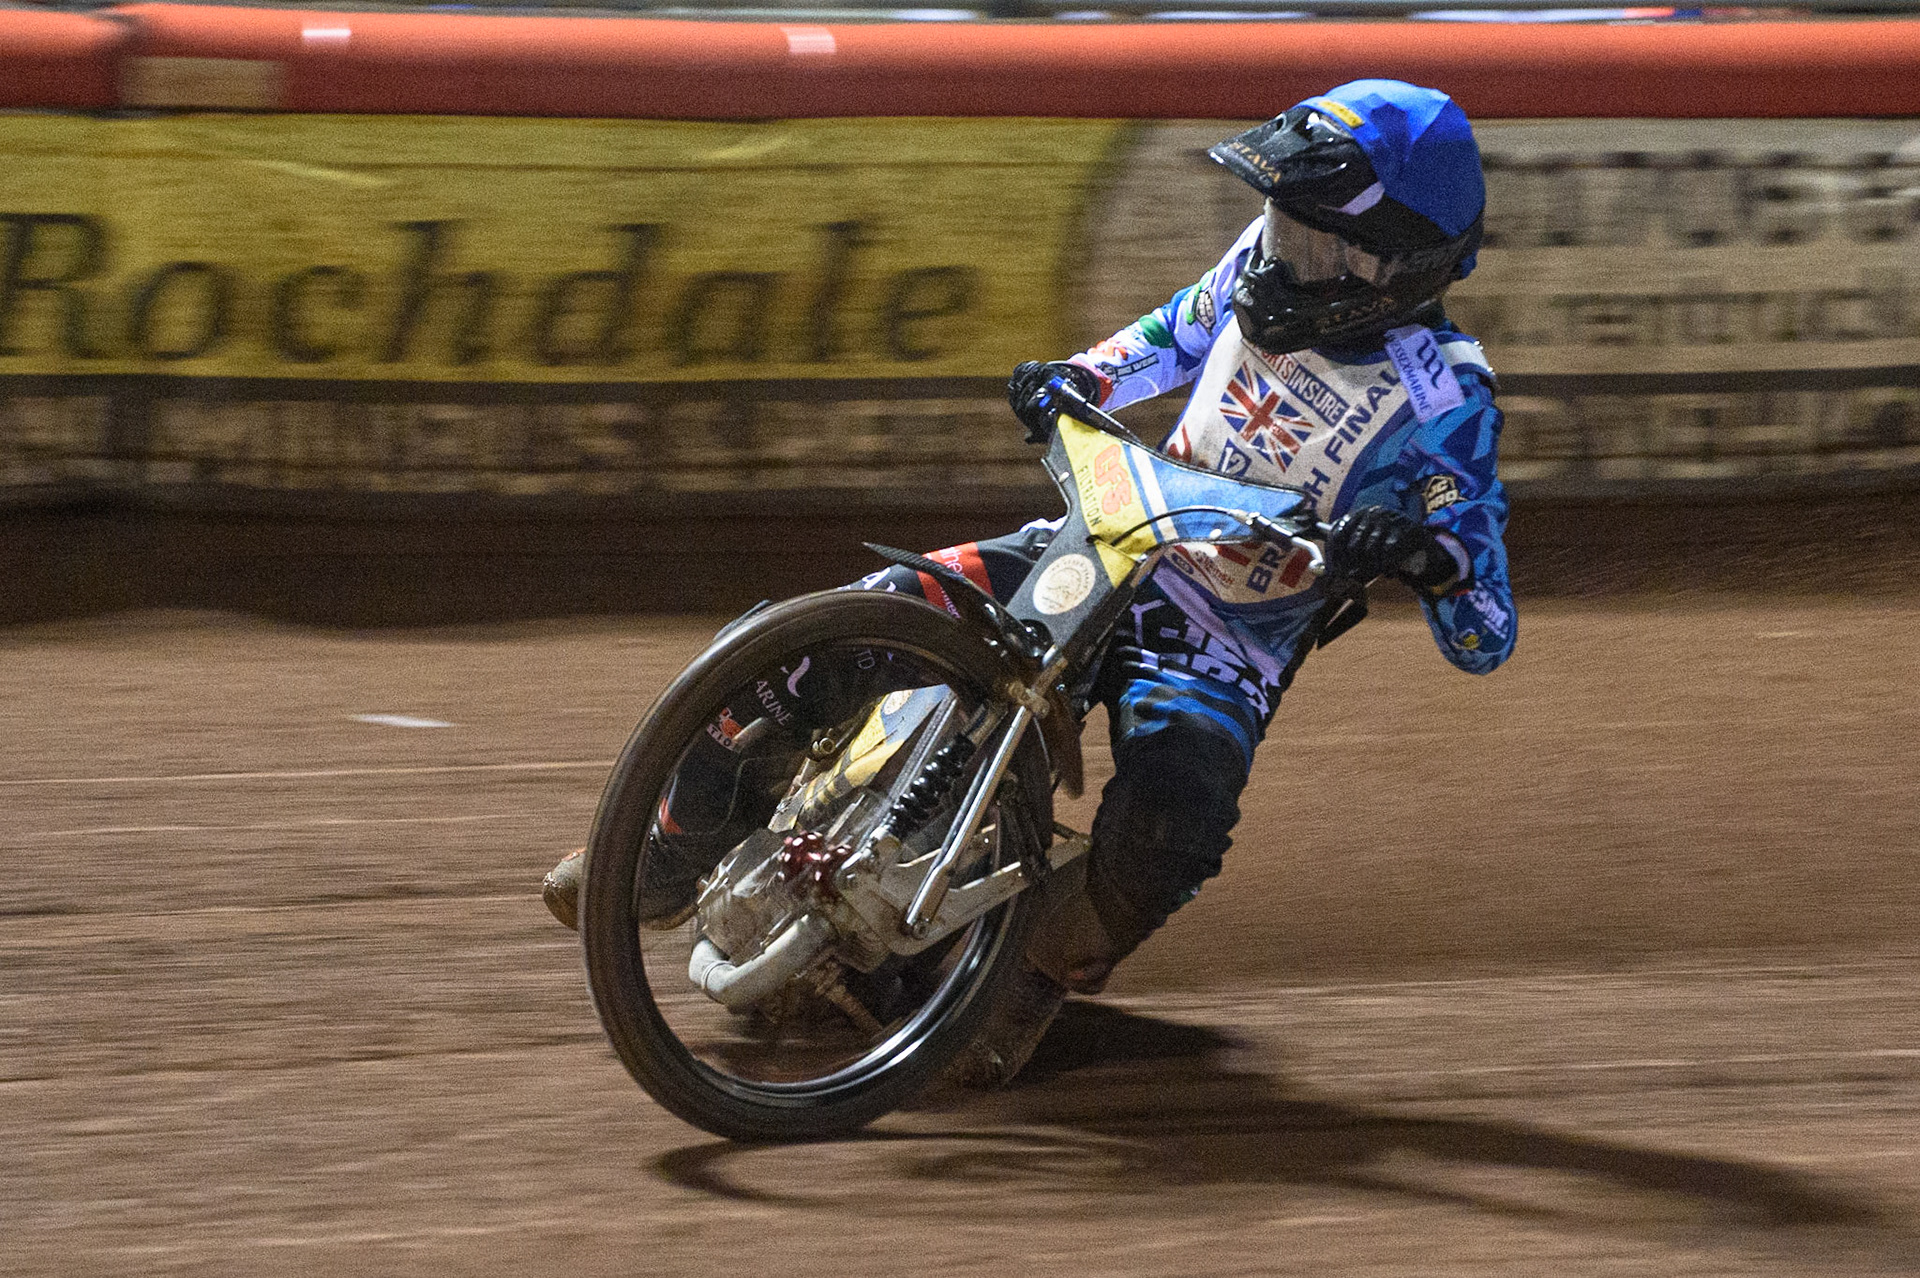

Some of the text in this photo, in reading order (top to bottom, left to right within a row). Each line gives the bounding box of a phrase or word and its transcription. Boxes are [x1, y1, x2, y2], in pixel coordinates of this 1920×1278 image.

[0, 211, 980, 367] Rochdale
[1290, 368, 1347, 425] INSURE
[1324, 366, 1401, 466] FINAL
